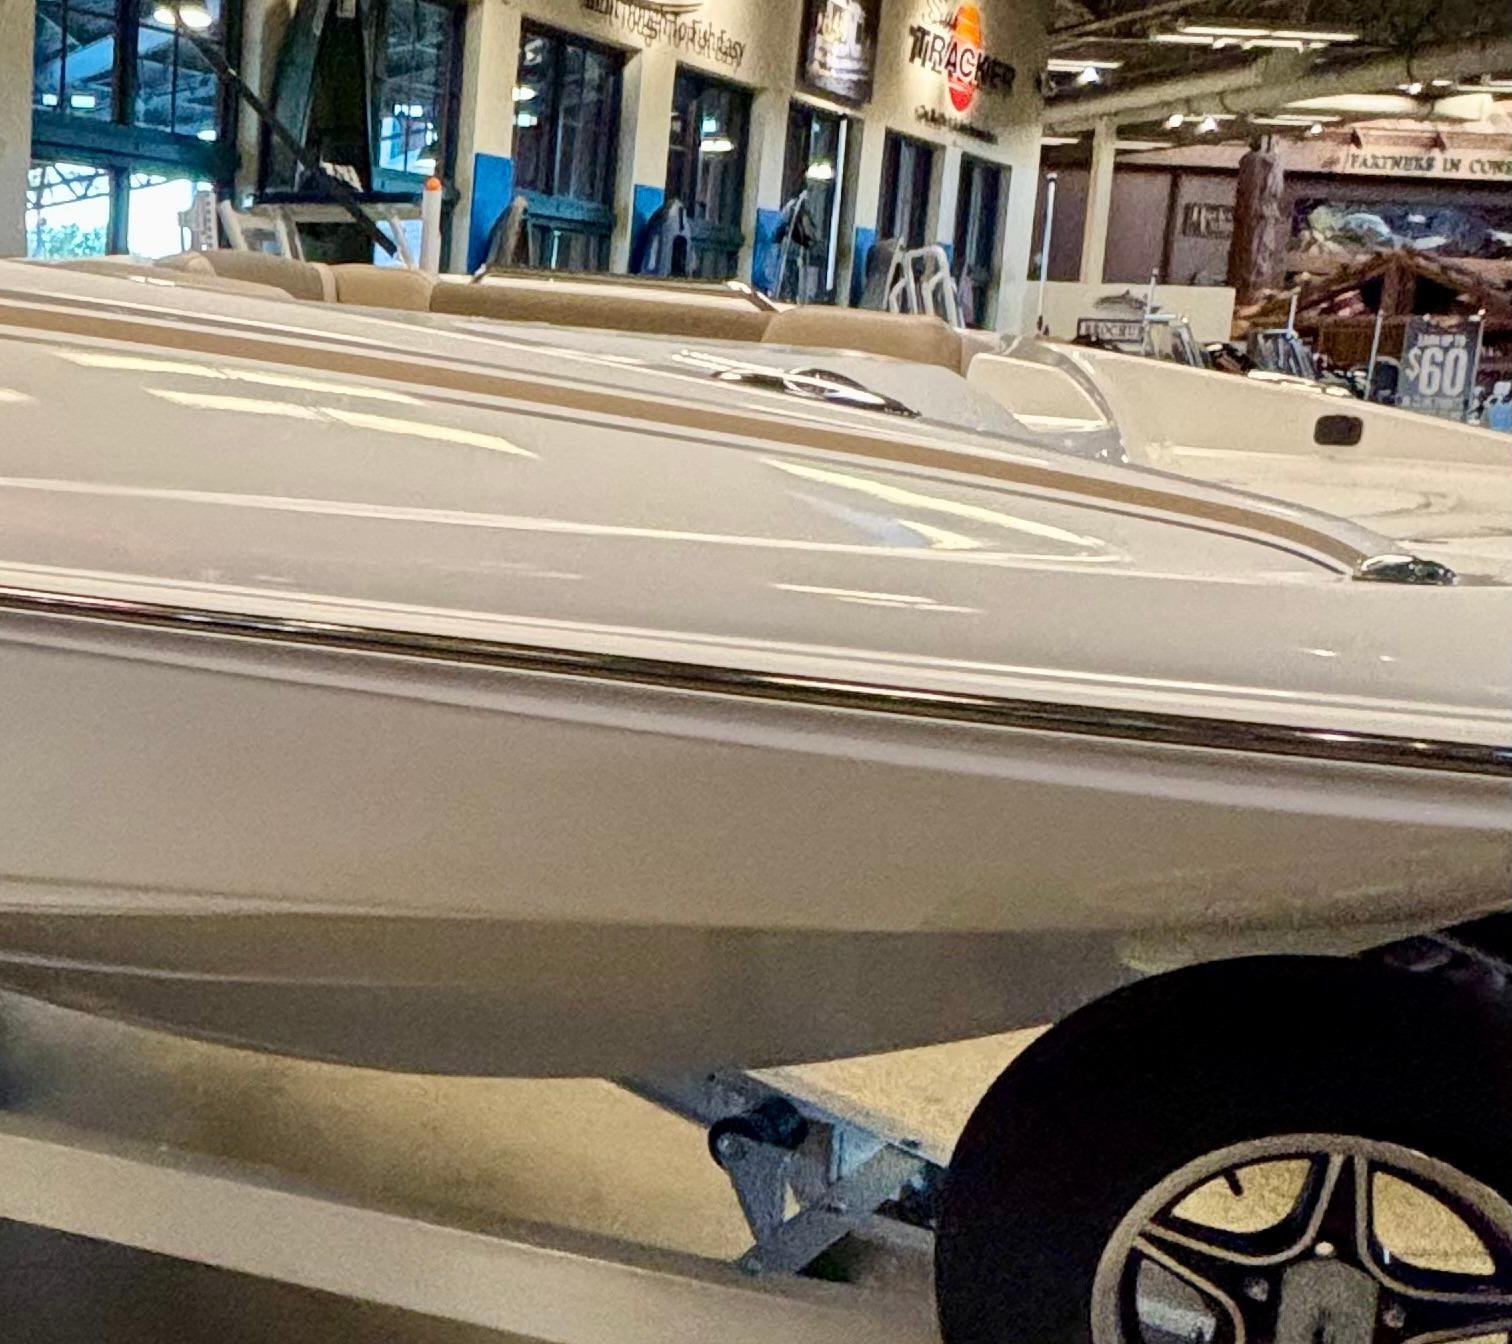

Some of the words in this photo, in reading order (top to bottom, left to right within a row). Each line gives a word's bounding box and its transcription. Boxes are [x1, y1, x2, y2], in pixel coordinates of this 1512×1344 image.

[908, 24, 1017, 95] TRACKER
[1442, 157, 1461, 172] IN
[1405, 346, 1468, 397] $60
